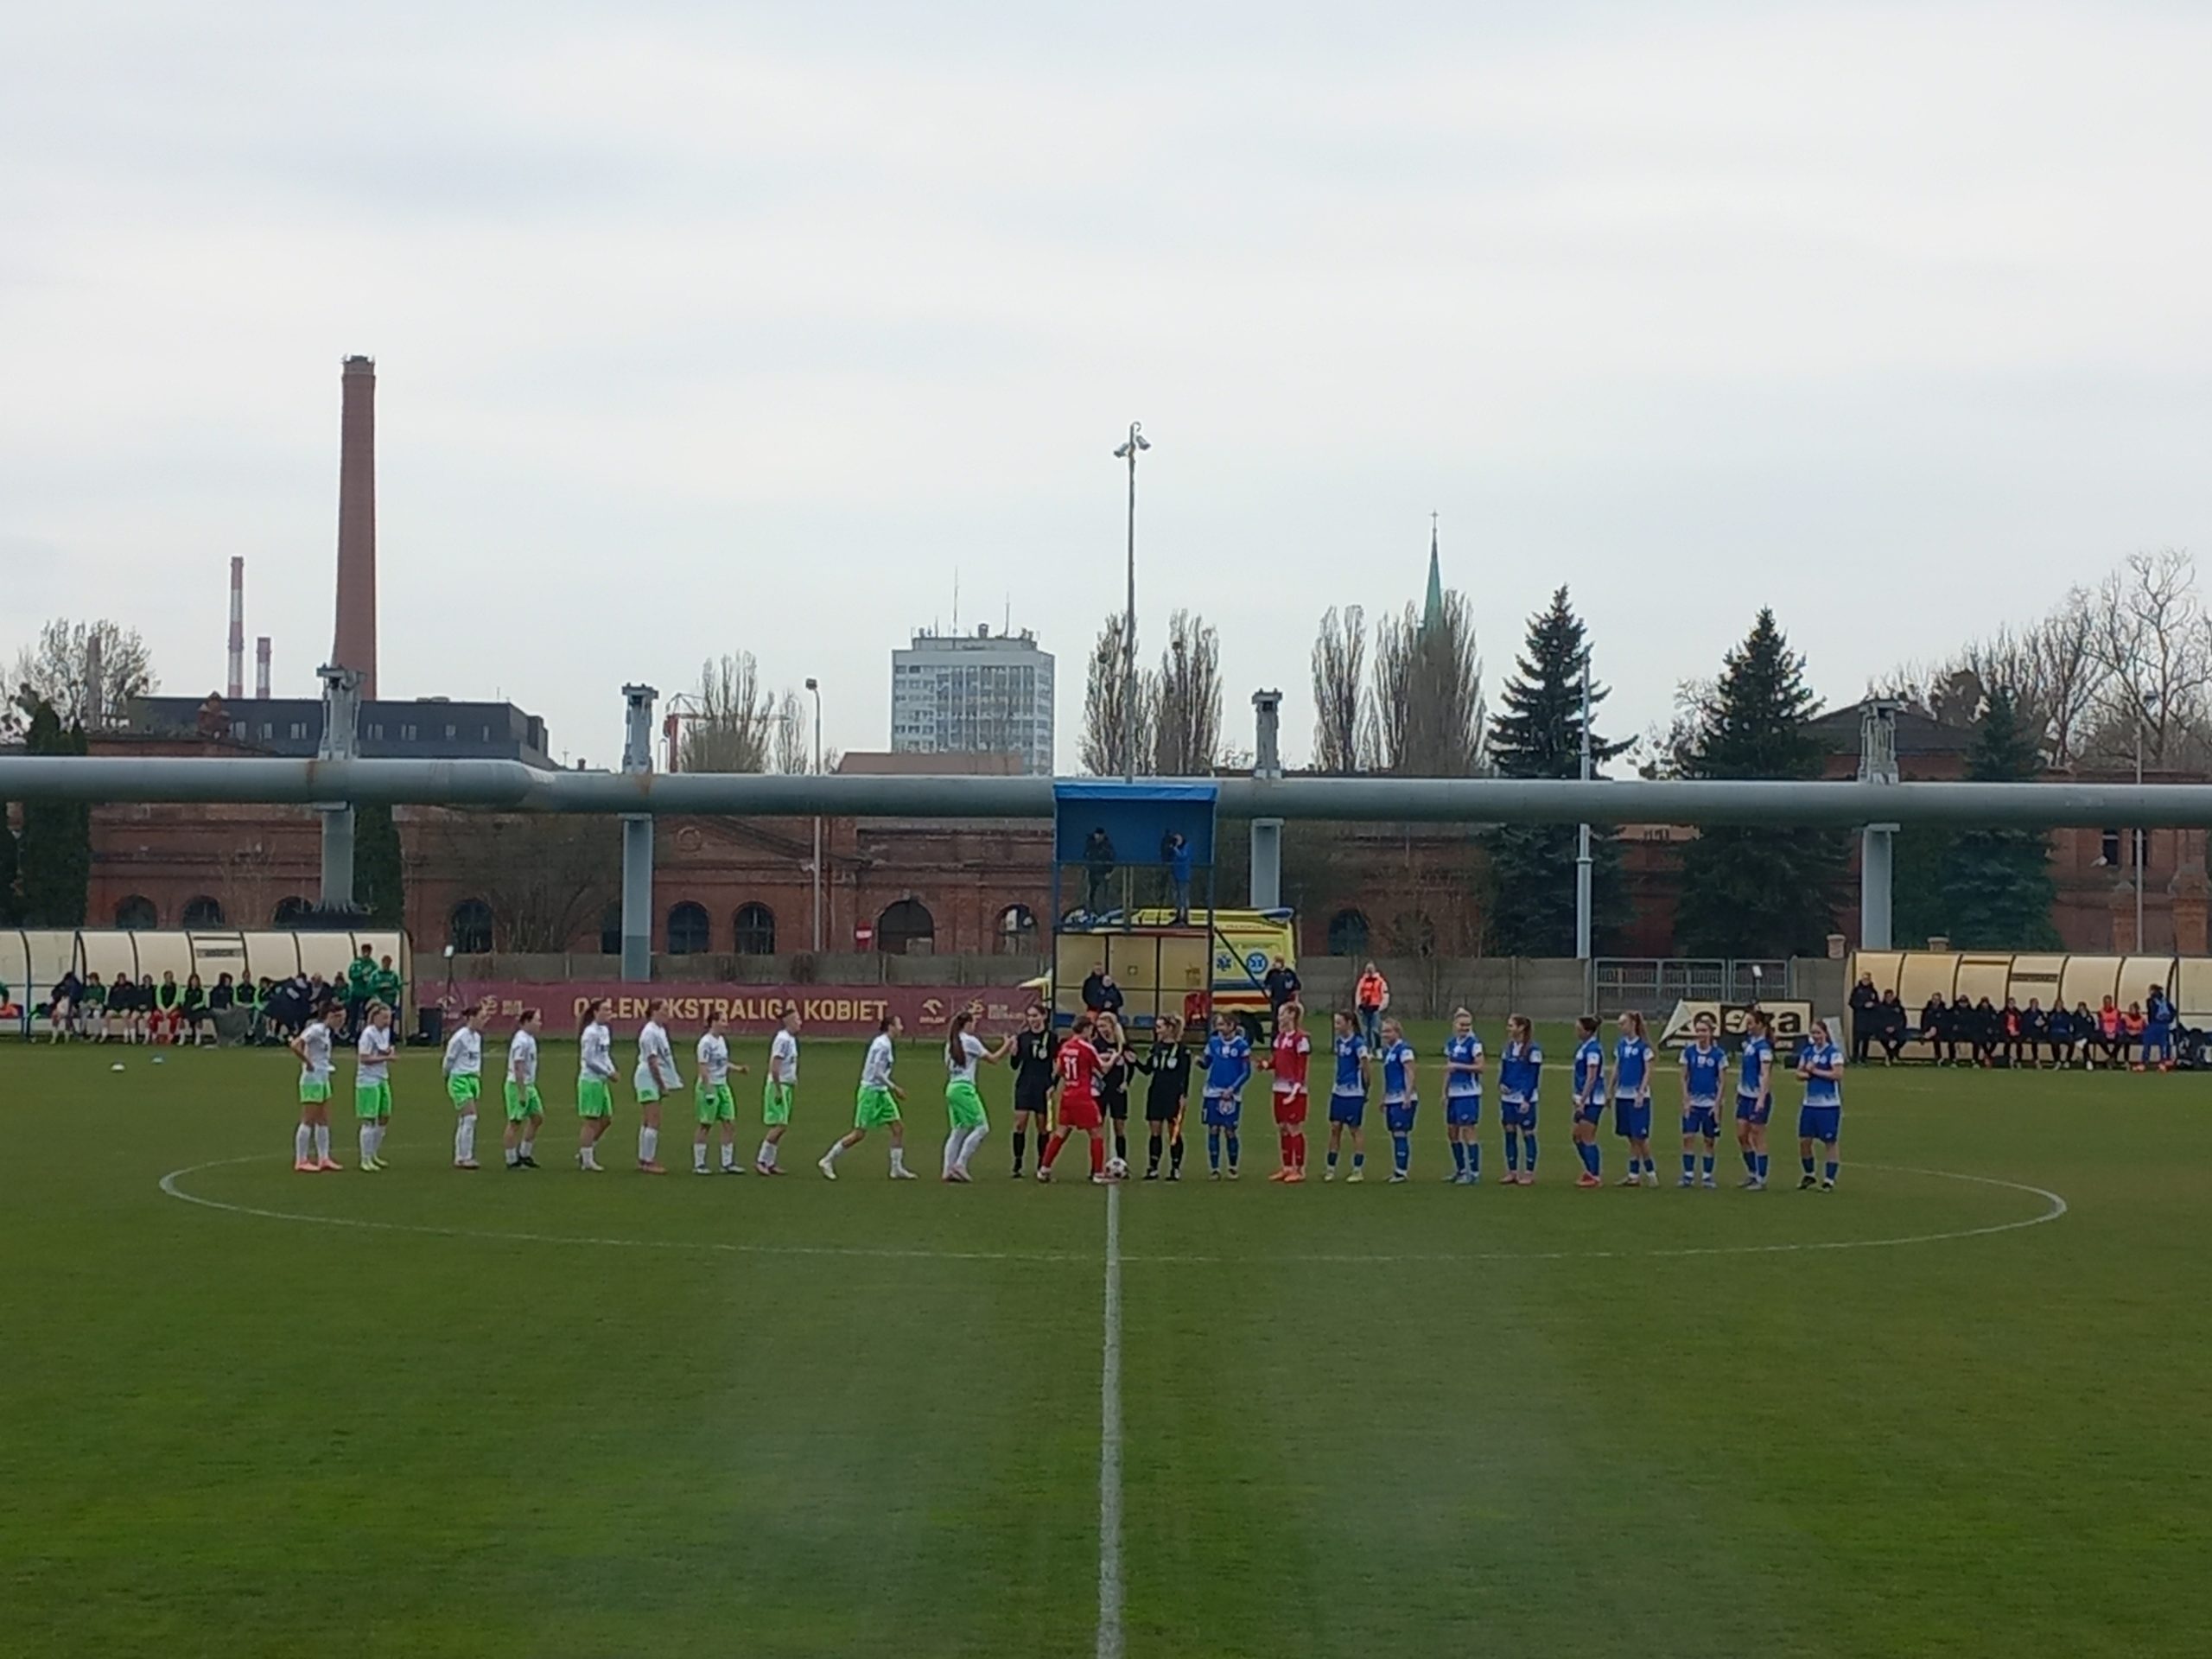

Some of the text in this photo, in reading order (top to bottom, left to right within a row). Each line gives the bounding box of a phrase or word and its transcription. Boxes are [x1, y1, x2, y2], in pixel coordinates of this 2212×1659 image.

[574, 996, 888, 1021] OLEN KSTRALIGA KOBIET
